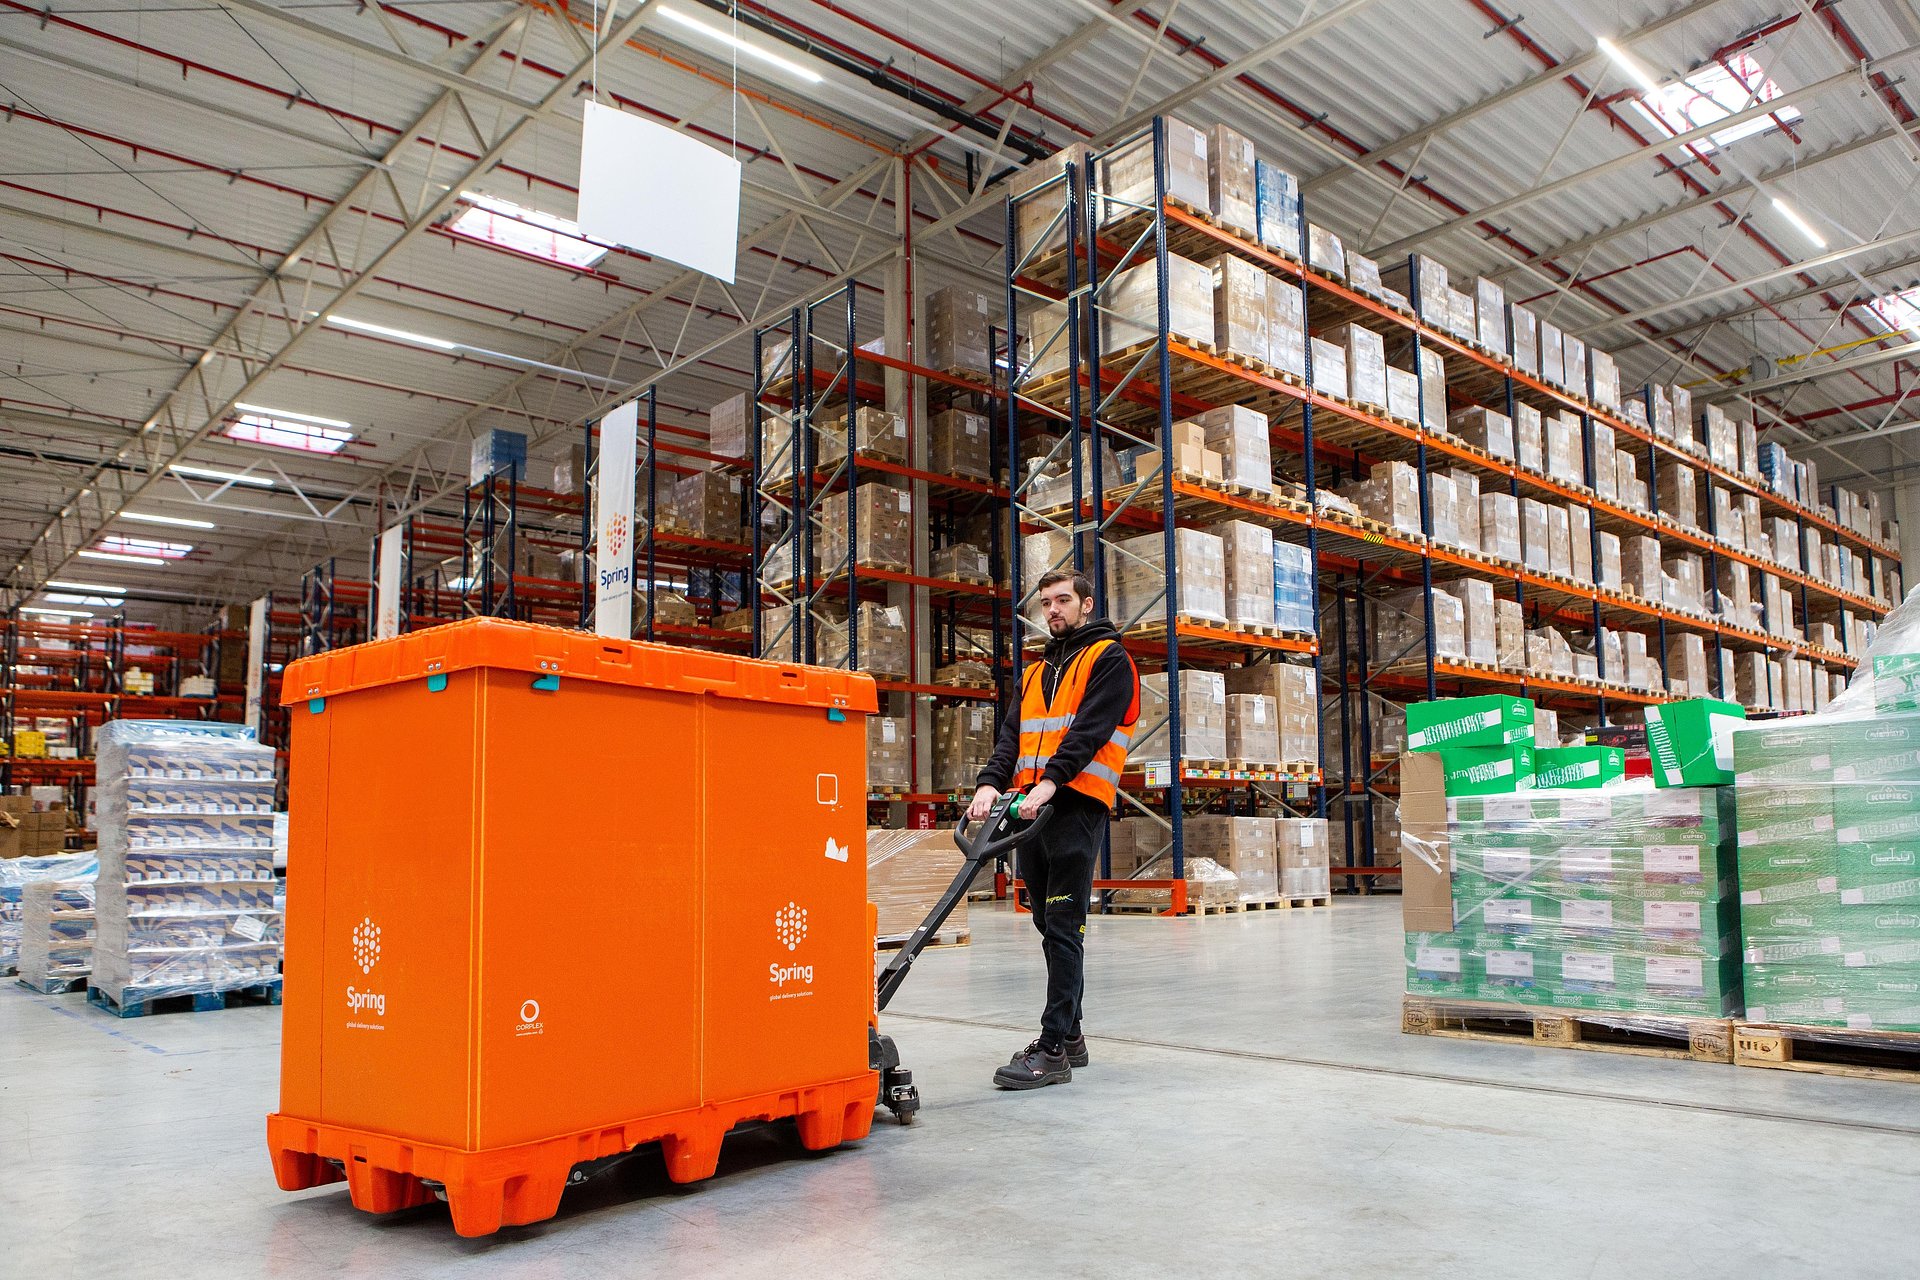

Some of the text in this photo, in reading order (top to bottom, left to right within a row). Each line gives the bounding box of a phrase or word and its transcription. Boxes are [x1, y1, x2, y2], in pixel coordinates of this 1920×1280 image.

[601, 566, 629, 590] Spring
[1871, 792, 1908, 801] KUPIEC
[770, 962, 813, 987] Spring
[346, 985, 385, 1016] Spring
[516, 1022, 543, 1031] CORPLEX
[1697, 1038, 1721, 1050] EPAL
